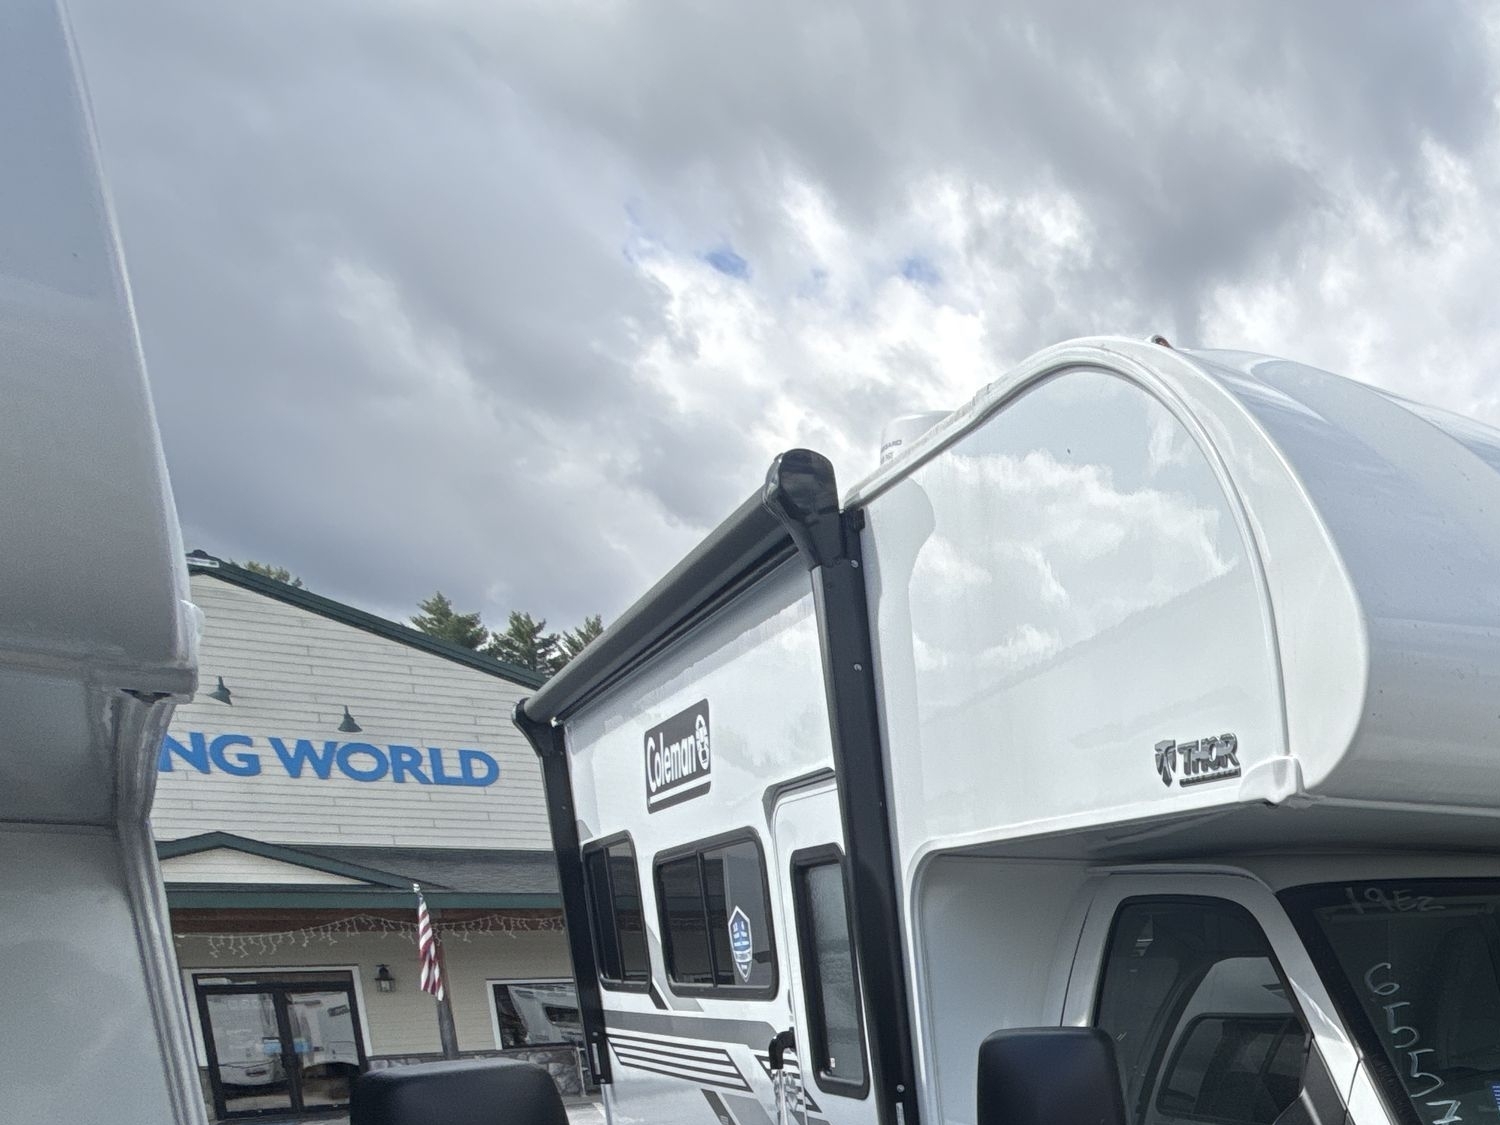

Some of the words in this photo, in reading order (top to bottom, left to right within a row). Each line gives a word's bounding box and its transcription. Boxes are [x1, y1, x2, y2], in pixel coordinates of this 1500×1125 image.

[268, 736, 500, 788] WORLD
[647, 732, 697, 793] Coleman
[1177, 732, 1240, 776] THOR
